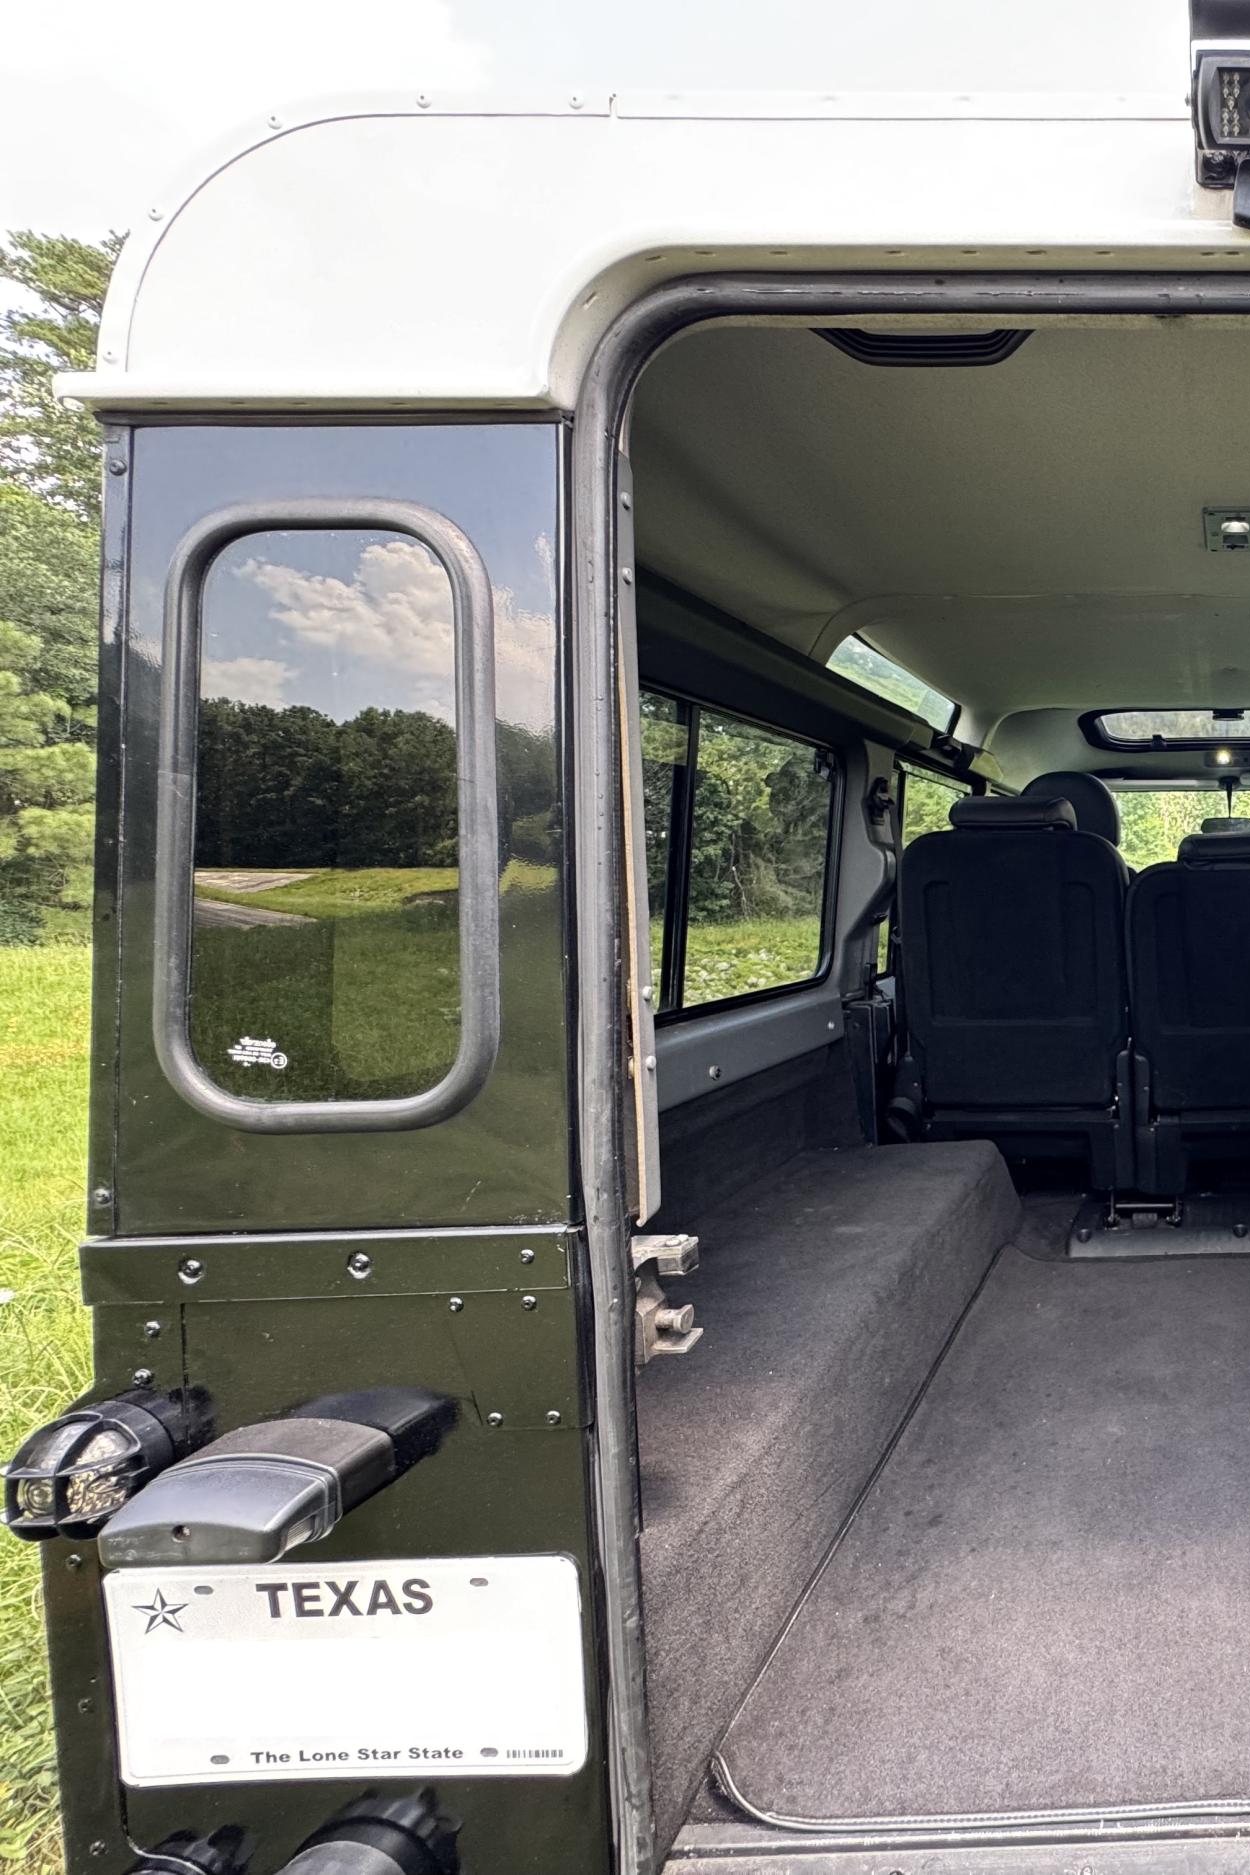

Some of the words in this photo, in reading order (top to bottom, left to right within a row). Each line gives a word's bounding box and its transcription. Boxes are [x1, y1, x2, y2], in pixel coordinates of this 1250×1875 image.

[256, 1579, 432, 1617] TEXAS
[251, 1752, 290, 1763] The
[299, 1750, 349, 1761] Lone
[358, 1749, 400, 1760] Star
[409, 1748, 463, 1759] State
